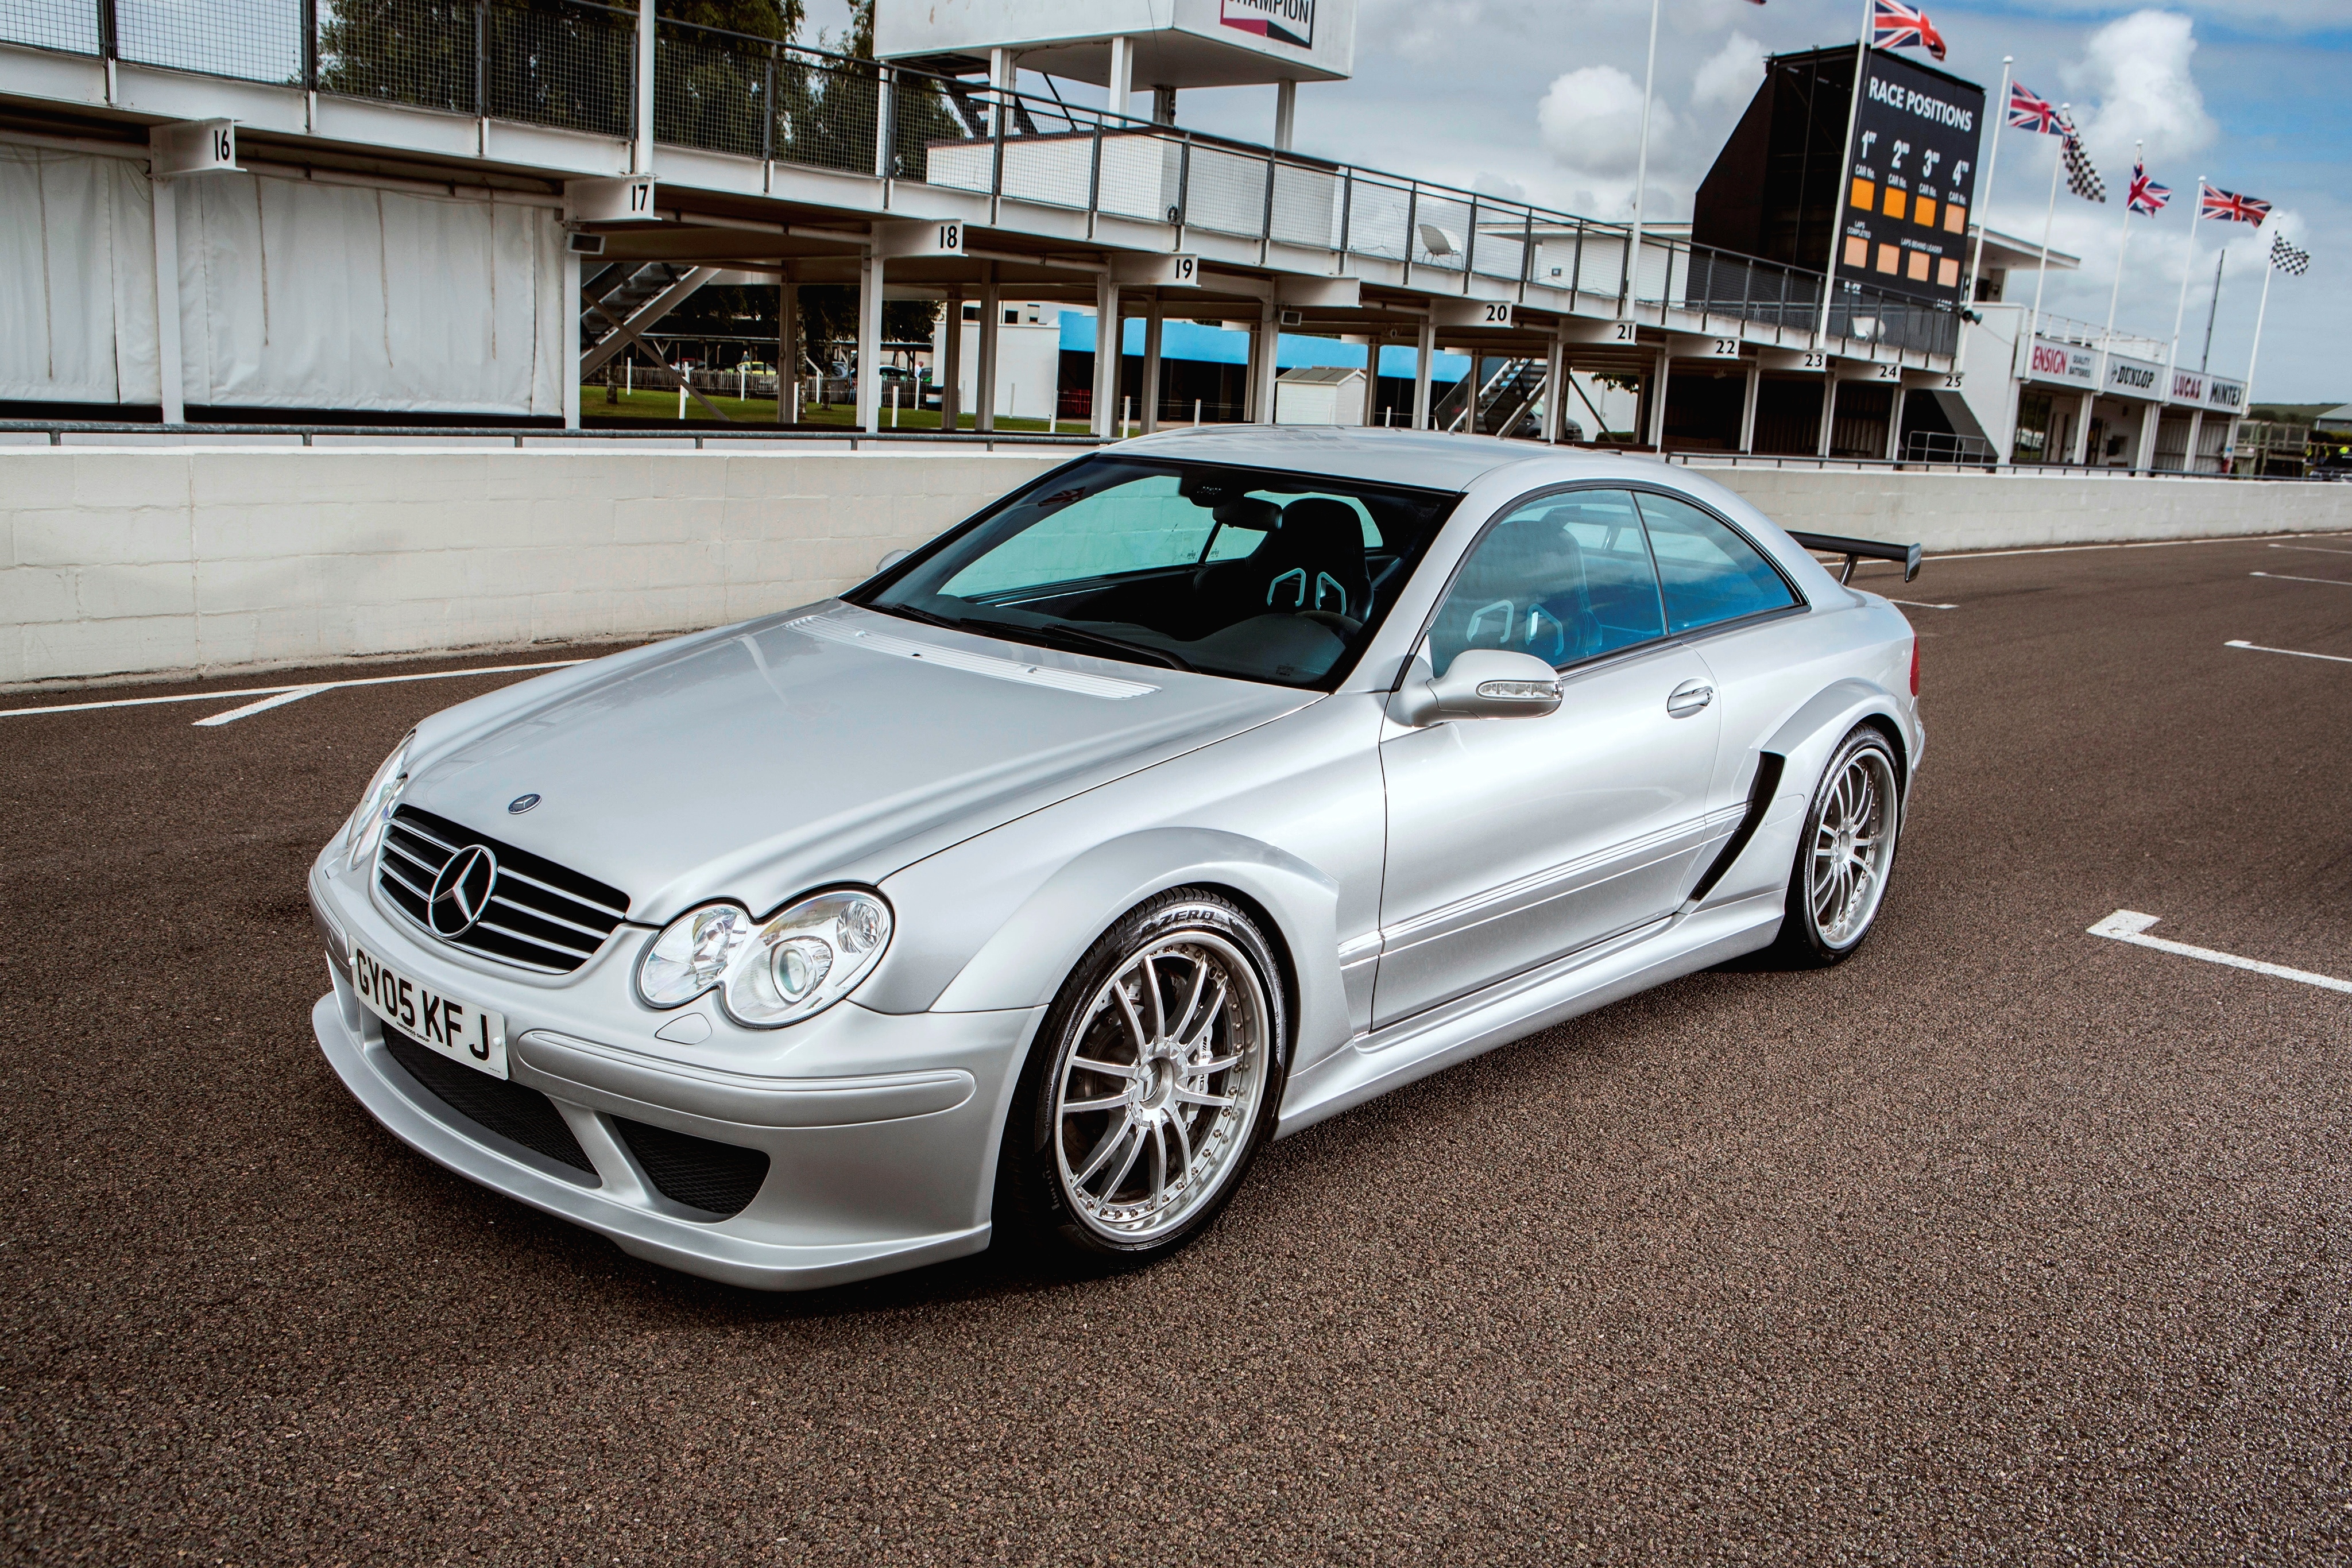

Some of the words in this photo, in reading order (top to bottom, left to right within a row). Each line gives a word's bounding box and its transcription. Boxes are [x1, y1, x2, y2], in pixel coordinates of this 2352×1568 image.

[1229, 0, 1309, 24] MPION
[1869, 76, 1905, 109] RACE
[1906, 90, 1972, 131] POSITIONS
[214, 129, 230, 161] 16
[1855, 164, 1866, 176] CAR
[1888, 173, 1898, 185] CAR
[1918, 183, 1929, 195] CAR
[1948, 191, 1958, 203] CAR
[632, 184, 648, 211] 17
[1855, 220, 1865, 229] LAPS
[939, 225, 958, 249] 18
[1847, 227, 1871, 239] COMPLETED
[1901, 237, 1912, 247] LAPS
[1927, 243, 1943, 254] LEADER
[1175, 258, 1193, 280] 19
[1486, 305, 1507, 322] 20
[1617, 324, 1633, 340] 21
[1716, 340, 1735, 354] 22
[1805, 354, 1823, 367] 23
[2033, 346, 2068, 375] ENSIGN
[2073, 355, 2090, 366] QUALITY
[1879, 365, 1897, 378] 24
[2069, 366, 2091, 378] BATTERIES
[2117, 366, 2154, 388] DUNLOP
[1945, 375, 1962, 388] 25
[2173, 375, 2202, 400] LUCAS
[1158, 909, 1215, 928] ZERO
[357, 948, 416, 1028] GY05
[416, 1033, 430, 1042] GROUP
